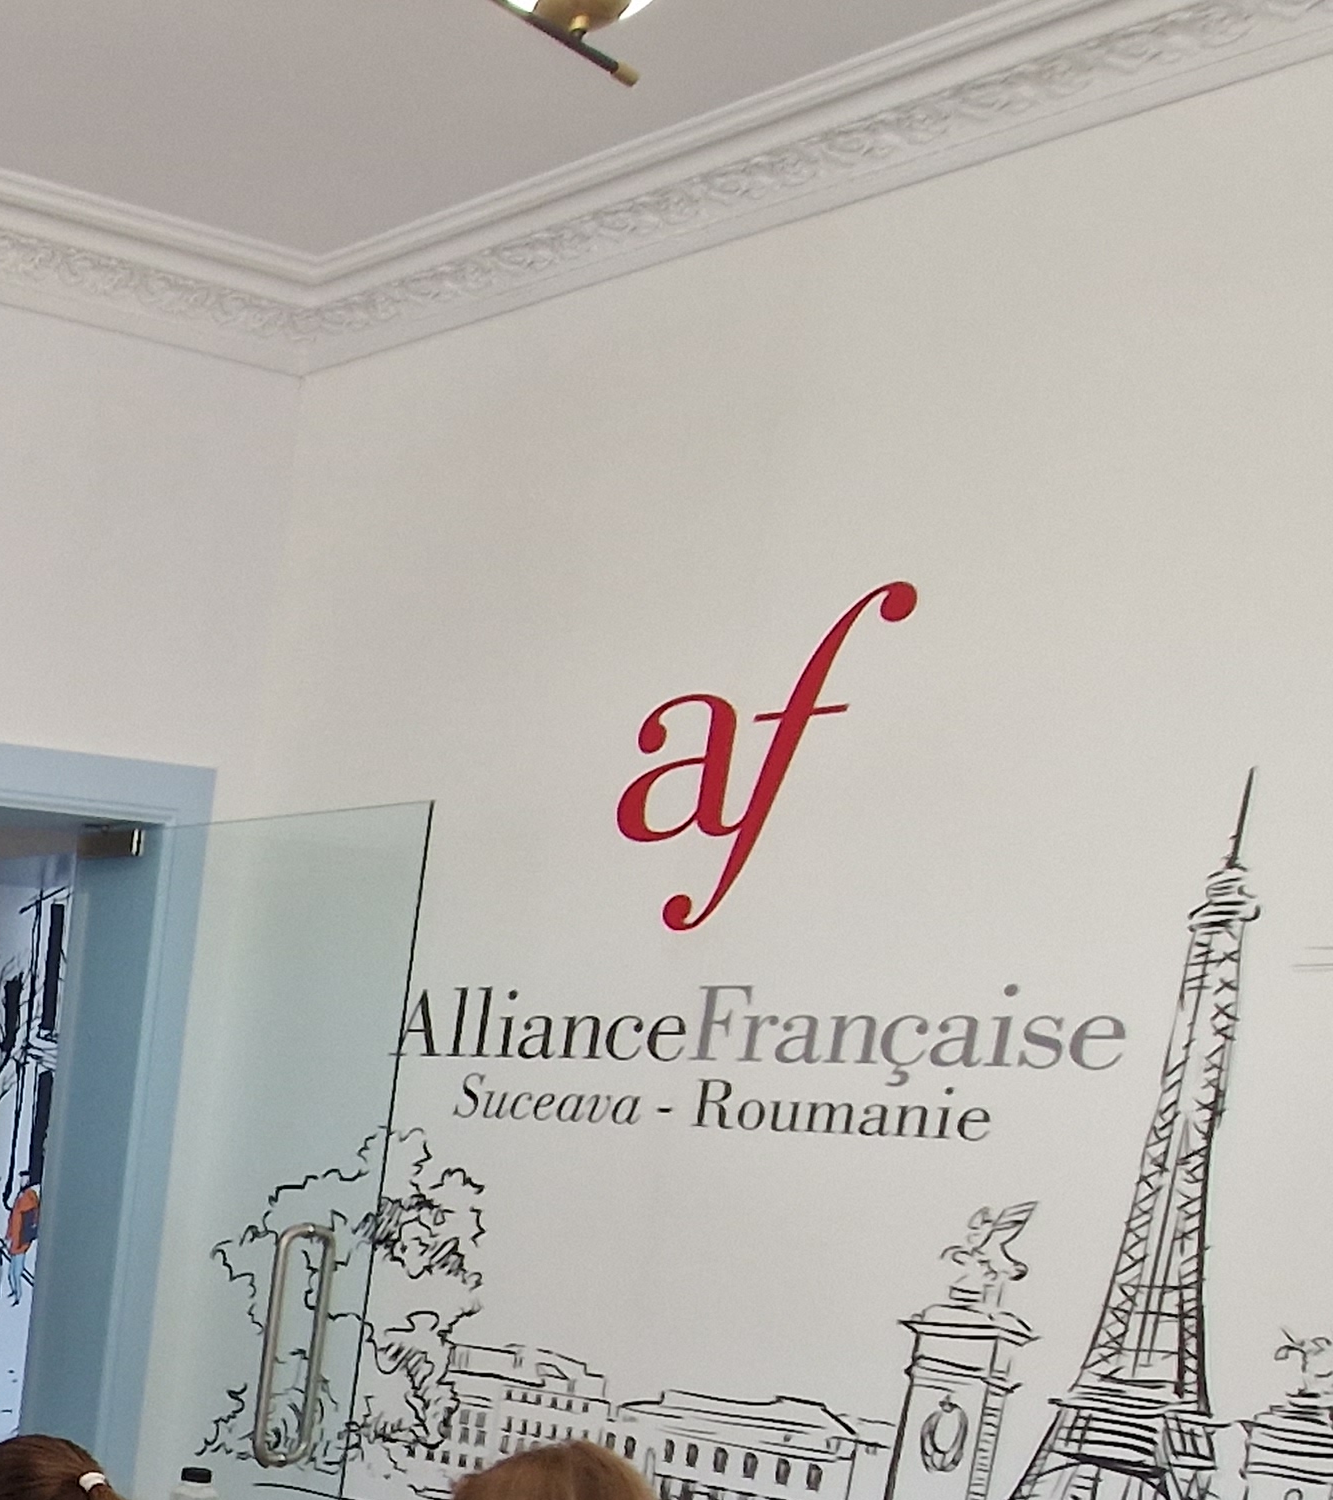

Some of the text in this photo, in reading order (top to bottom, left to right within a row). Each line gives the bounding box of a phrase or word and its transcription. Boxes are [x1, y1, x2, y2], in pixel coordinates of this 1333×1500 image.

[615, 580, 918, 932] af
[453, 1075, 644, 1127] Suceava
[691, 1080, 993, 1144] Roumanie
